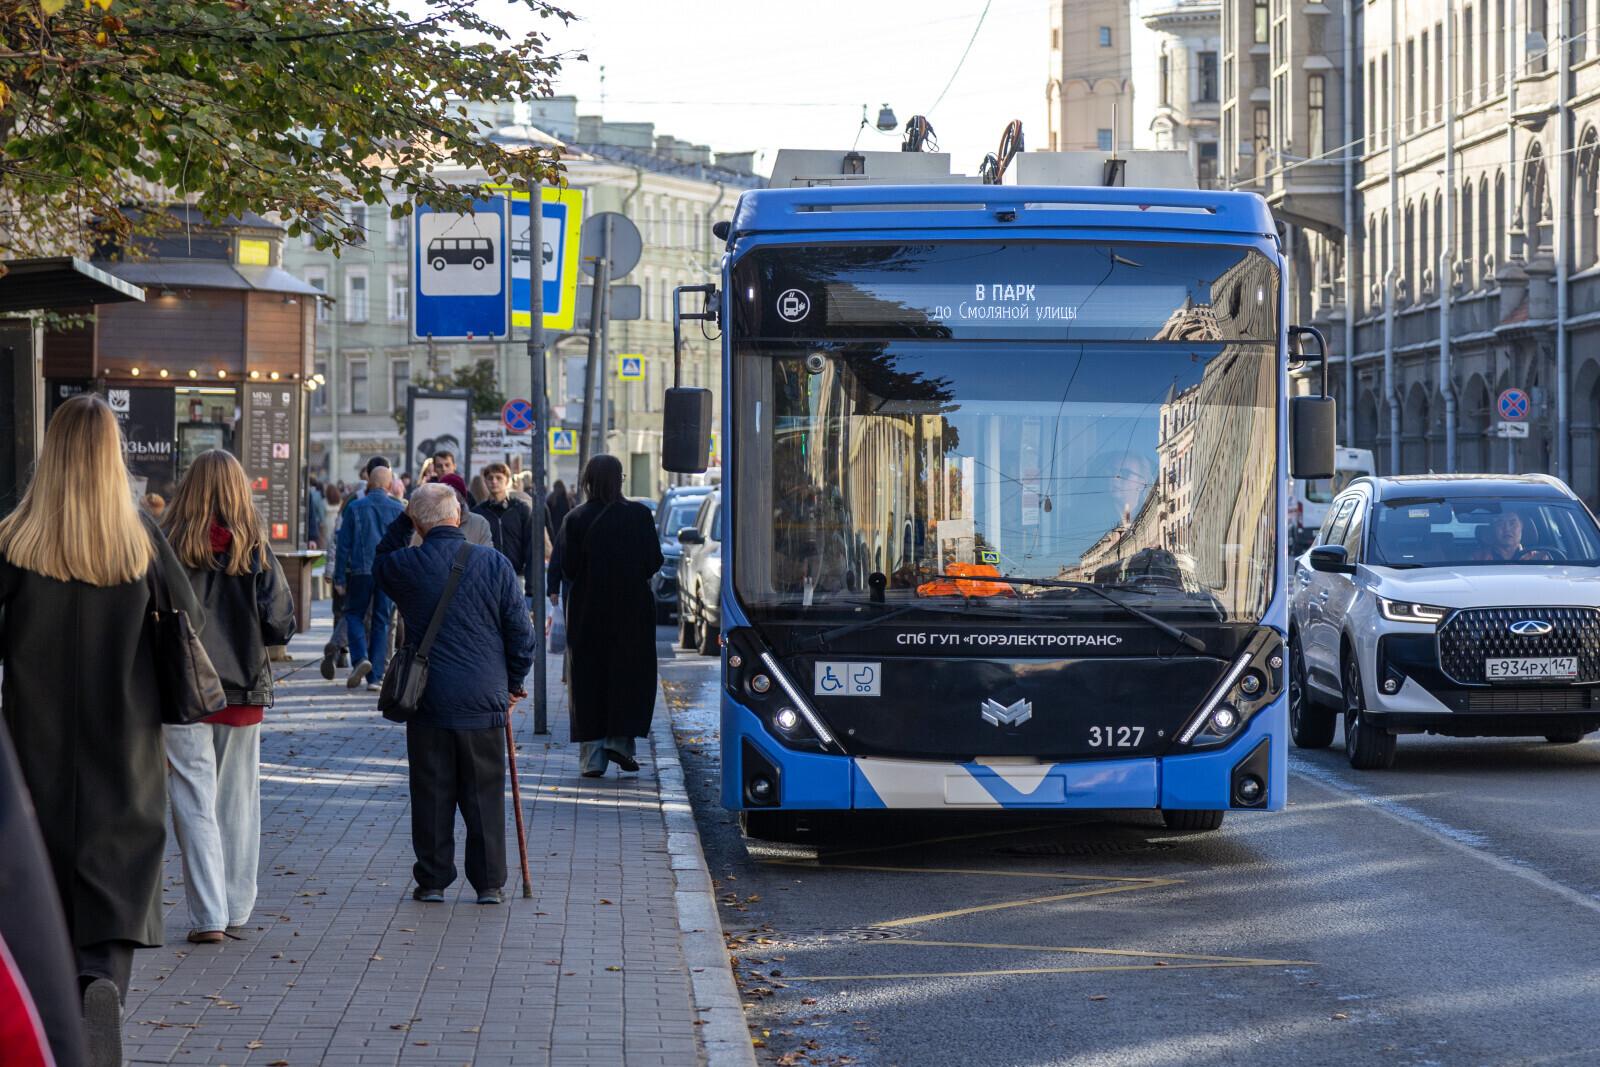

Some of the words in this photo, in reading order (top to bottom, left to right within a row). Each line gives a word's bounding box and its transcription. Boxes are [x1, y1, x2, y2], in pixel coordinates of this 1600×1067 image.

[975, 284, 985, 301] В
[992, 284, 1036, 301] ПАРК
[933, 305, 952, 320] до
[958, 301, 1029, 319] Смоляной
[1035, 306, 1077, 321] улицы
[896, 633, 927, 645] СПб
[930, 633, 960, 645] ГУП
[963, 634, 1123, 646] «ГОРЭЛЕКТРОТРАНС»
[1087, 726, 1146, 748] 3127
